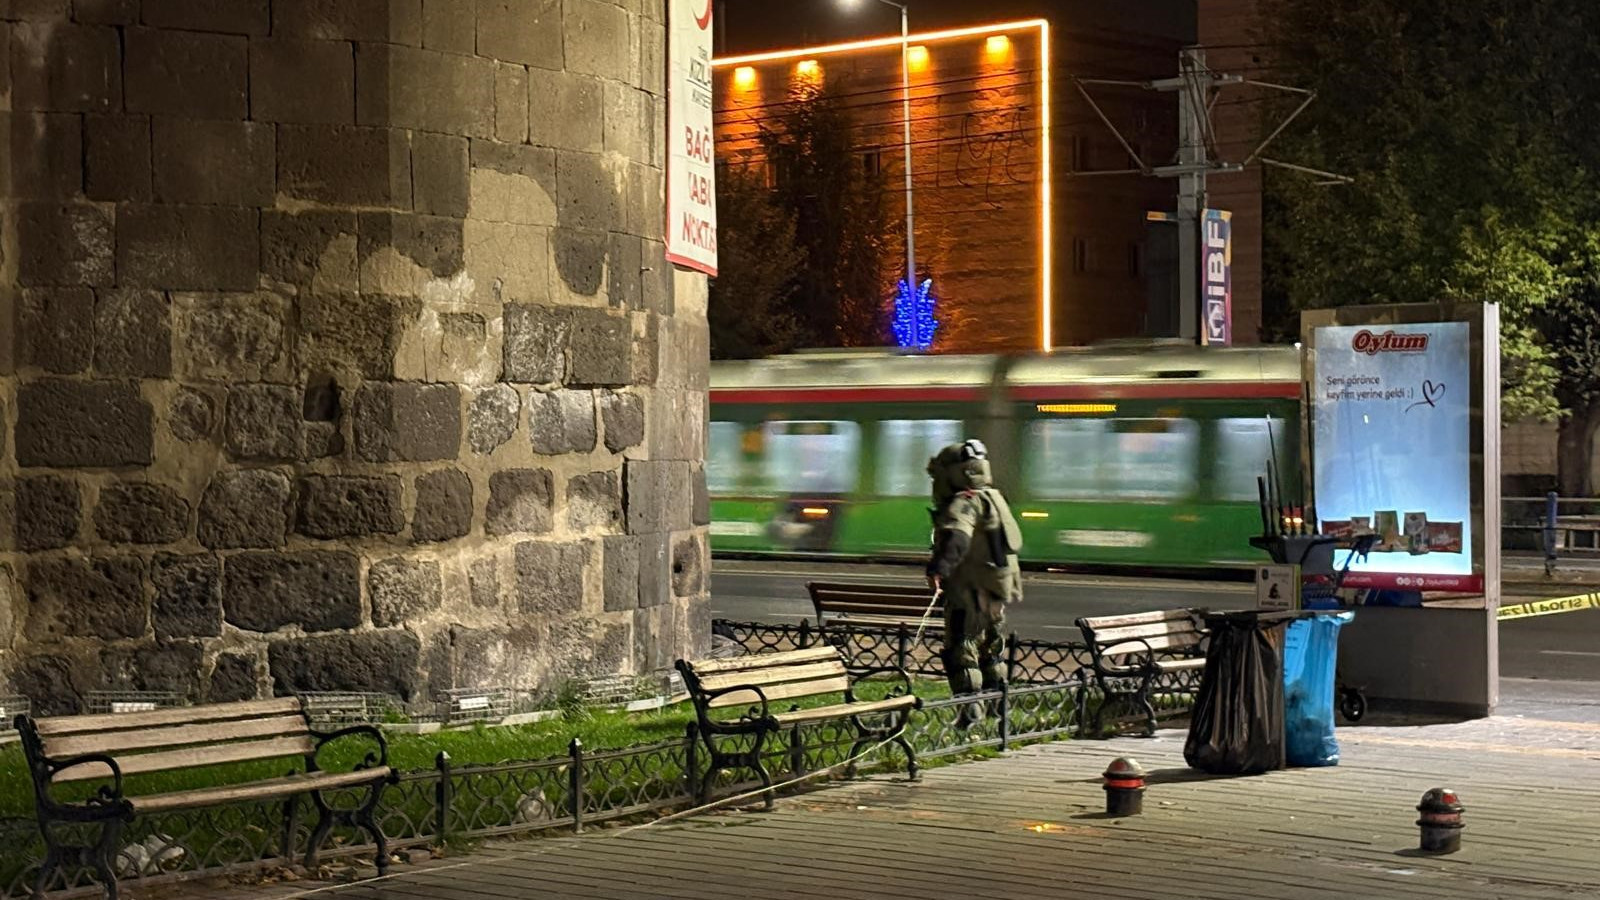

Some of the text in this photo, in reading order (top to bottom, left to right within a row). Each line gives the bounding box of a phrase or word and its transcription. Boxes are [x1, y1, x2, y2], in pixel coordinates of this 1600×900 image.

[1352, 329, 1429, 355] Oylum
[1326, 375, 1380, 388] Seni görünce
[1356, 387, 1383, 401] yerine
